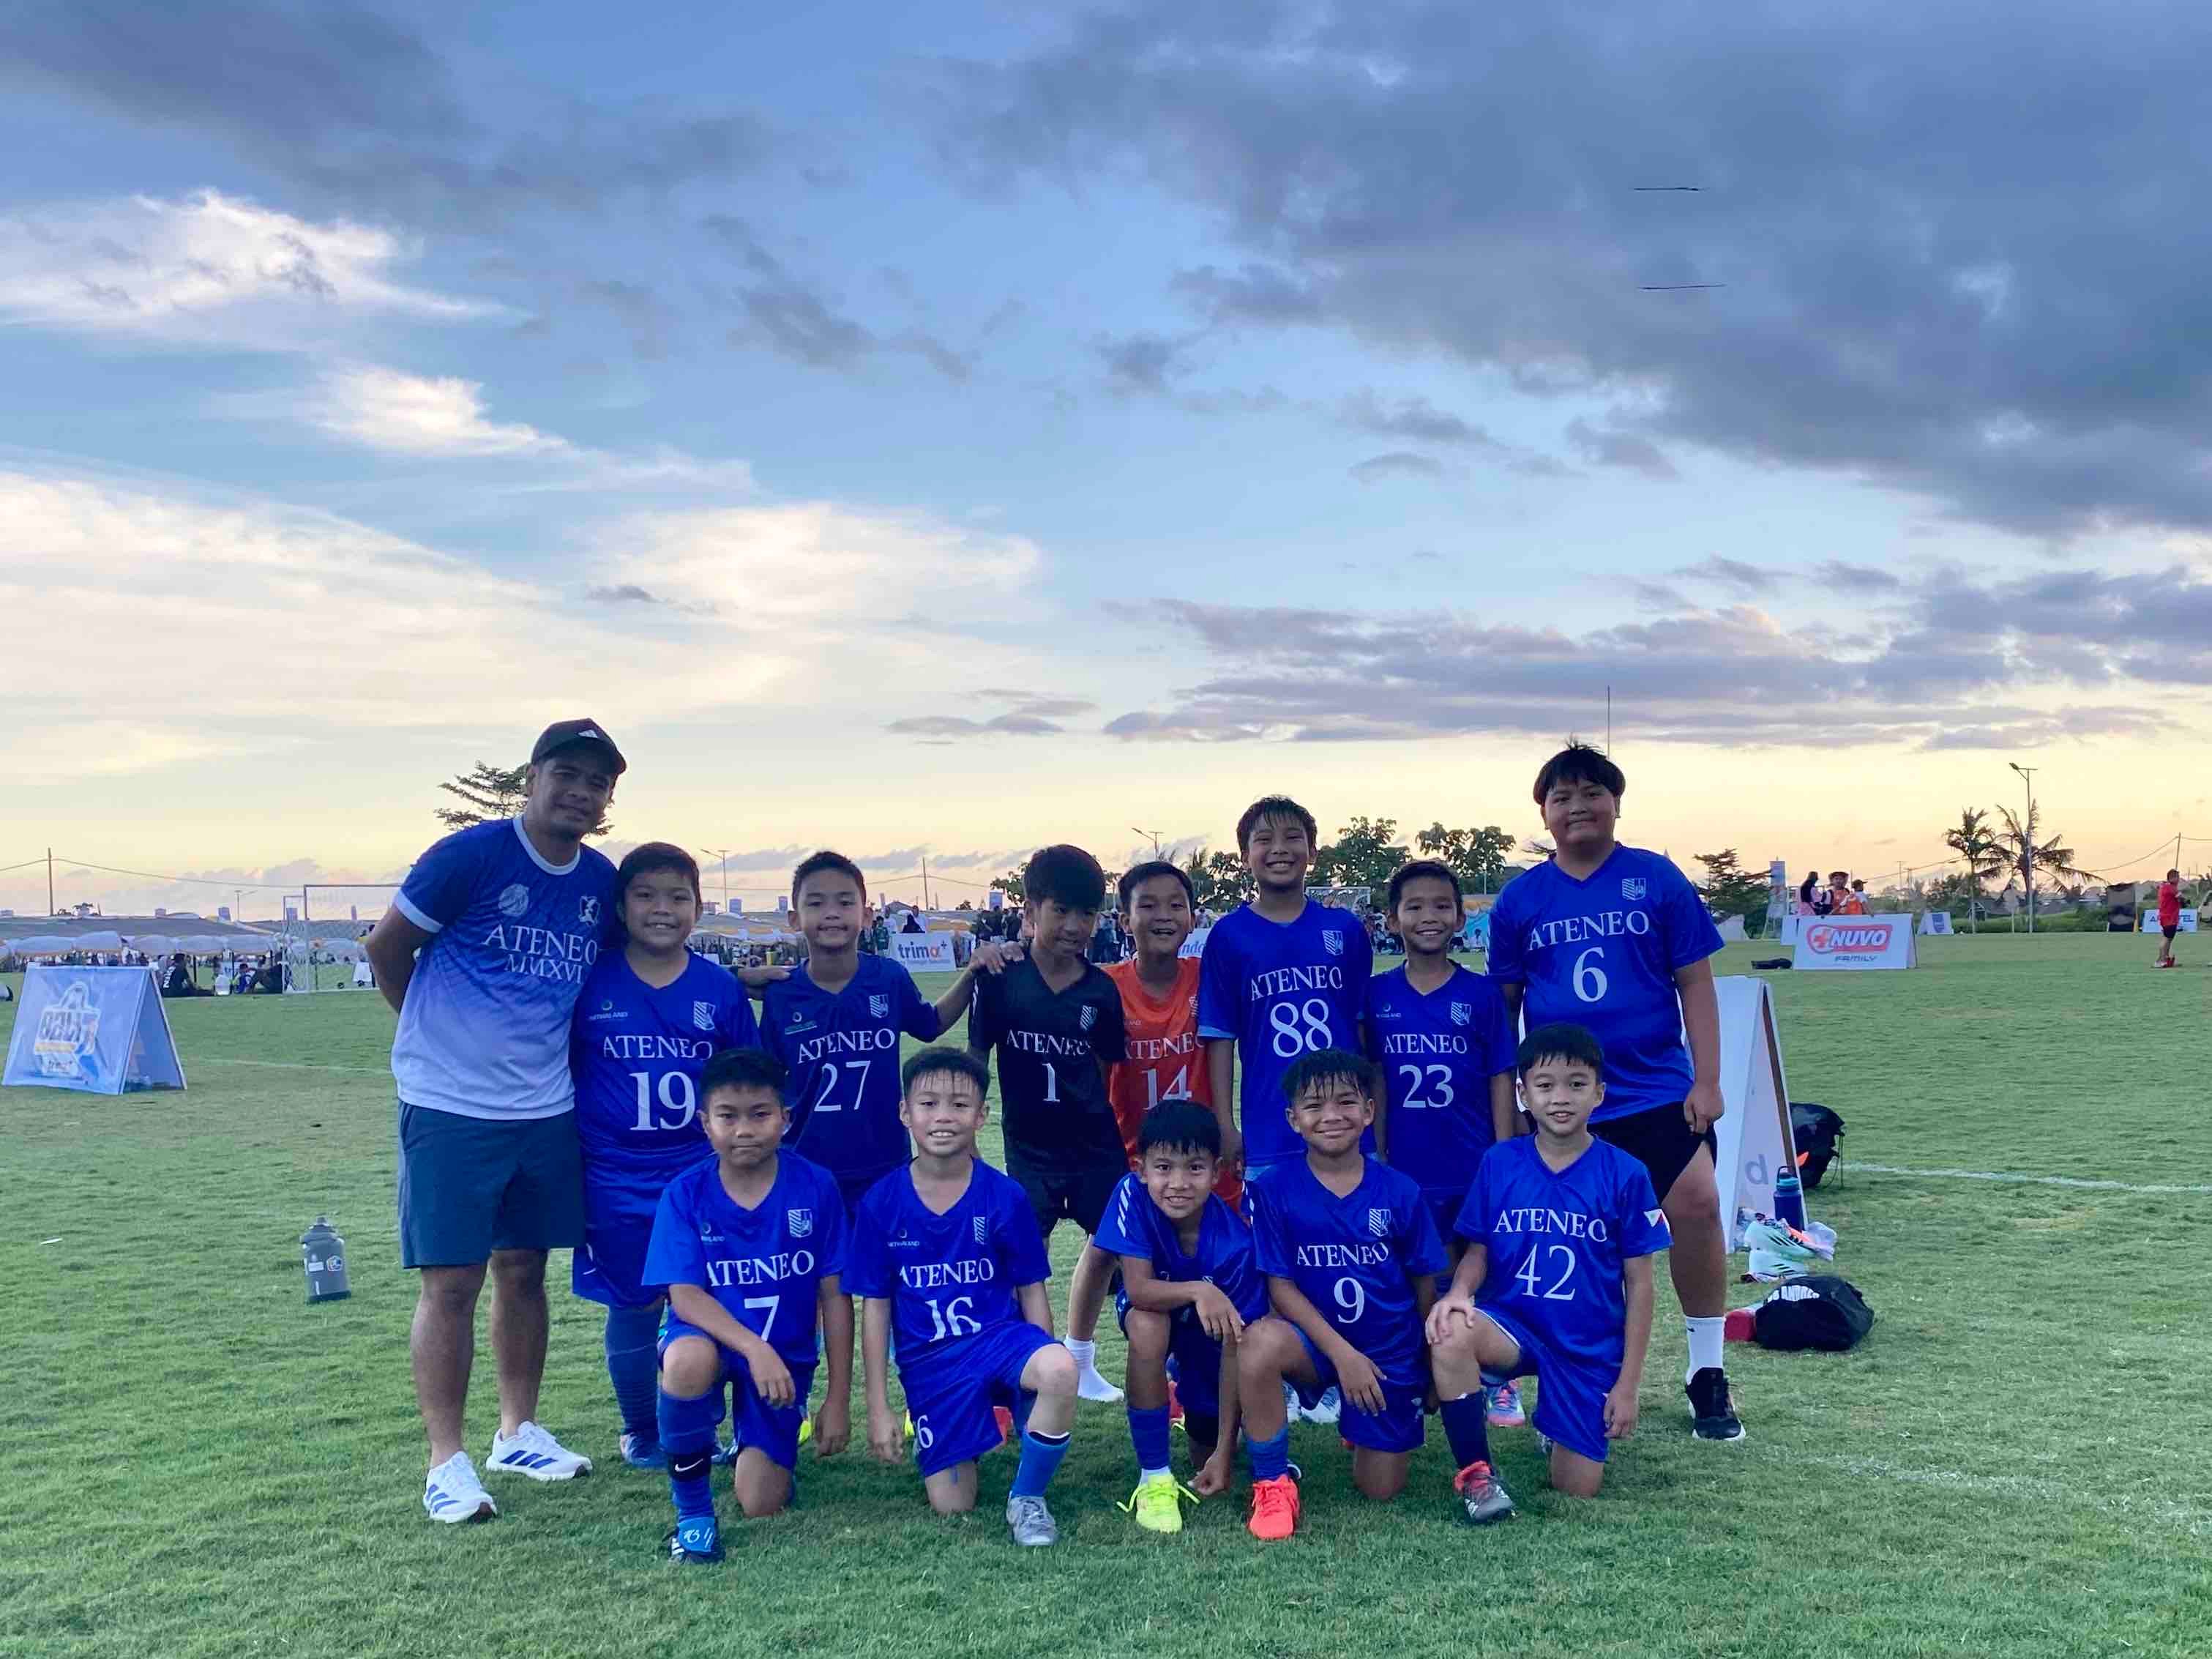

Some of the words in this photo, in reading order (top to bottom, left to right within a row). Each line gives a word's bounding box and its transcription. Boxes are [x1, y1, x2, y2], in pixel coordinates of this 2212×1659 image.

[480, 923, 599, 966] ATENEO
[1528, 910, 1650, 951] ATENEO
[1830, 930, 1888, 947] NUVO
[504, 953, 583, 985] MMXVI
[1250, 966, 1344, 1002] ATENEO
[1573, 946, 1608, 1002] 6
[602, 1034, 713, 1060] ATENEO
[797, 1027, 896, 1065] ATENEO
[1270, 998, 1333, 1058] 88
[1383, 1034, 1468, 1054] ATENEO
[628, 1070, 696, 1132] 19
[813, 1059, 872, 1112] 27
[1042, 1062, 1061, 1103] 1
[1140, 1064, 1193, 1111] 14
[1399, 1064, 1454, 1108] 23
[1492, 1208, 1608, 1242] ATENEO
[706, 1250, 815, 1287] ATENEO
[899, 1258, 995, 1289] ATENEO
[1296, 1242, 1389, 1267] ATENEO
[1514, 1242, 1576, 1301] 42
[743, 1294, 780, 1342] 7
[924, 1296, 982, 1343] 16
[1334, 1277, 1365, 1324] 9
